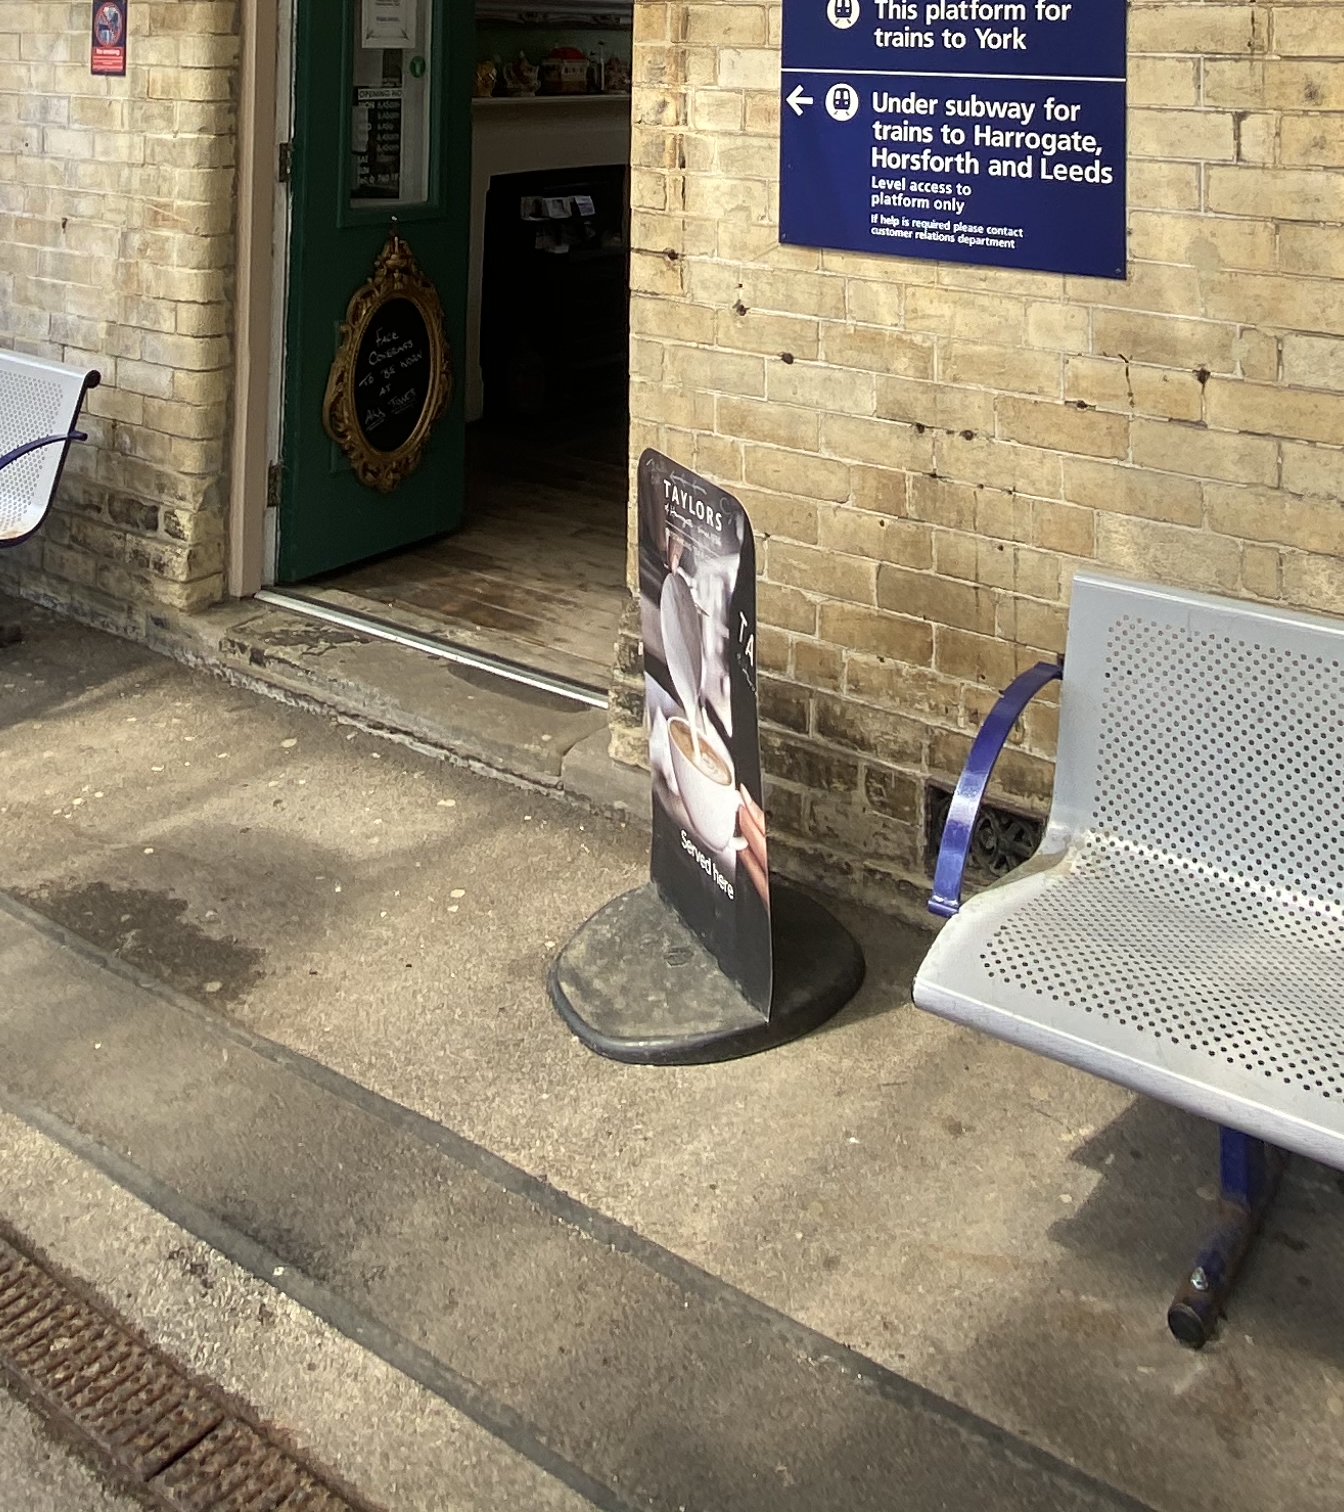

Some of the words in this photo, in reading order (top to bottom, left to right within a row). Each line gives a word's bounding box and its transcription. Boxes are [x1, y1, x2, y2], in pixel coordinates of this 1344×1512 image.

[874, 25, 935, 49] trains
[941, 28, 967, 49] to
[974, 26, 1027, 50] York
[359, 89, 392, 99] OPENING
[872, 91, 939, 116] Under
[945, 94, 1036, 126] subway
[1043, 97, 1081, 122] for
[872, 119, 934, 144] trains
[940, 123, 966, 146] to
[973, 124, 1104, 157] Harrogate,
[871, 146, 980, 175] Horsforth
[987, 156, 1033, 180] and
[1040, 157, 1114, 185] Leeds
[871, 175, 906, 191] Level
[909, 179, 953, 195] access
[956, 182, 972, 196] to
[871, 191, 930, 209] platform
[933, 197, 965, 215] only
[870, 213, 879, 224] If
[880, 214, 899, 228] help
[901, 216, 910, 227] is
[911, 219, 951, 233] required
[953, 221, 984, 234] please
[986, 225, 1024, 238] contact
[871, 226, 913, 239] customer
[914, 228, 955, 243] relations
[957, 233, 1016, 250] department
[663, 478, 723, 533] TAYLORS
[680, 828, 712, 877] Served
[712, 862, 735, 900] here
